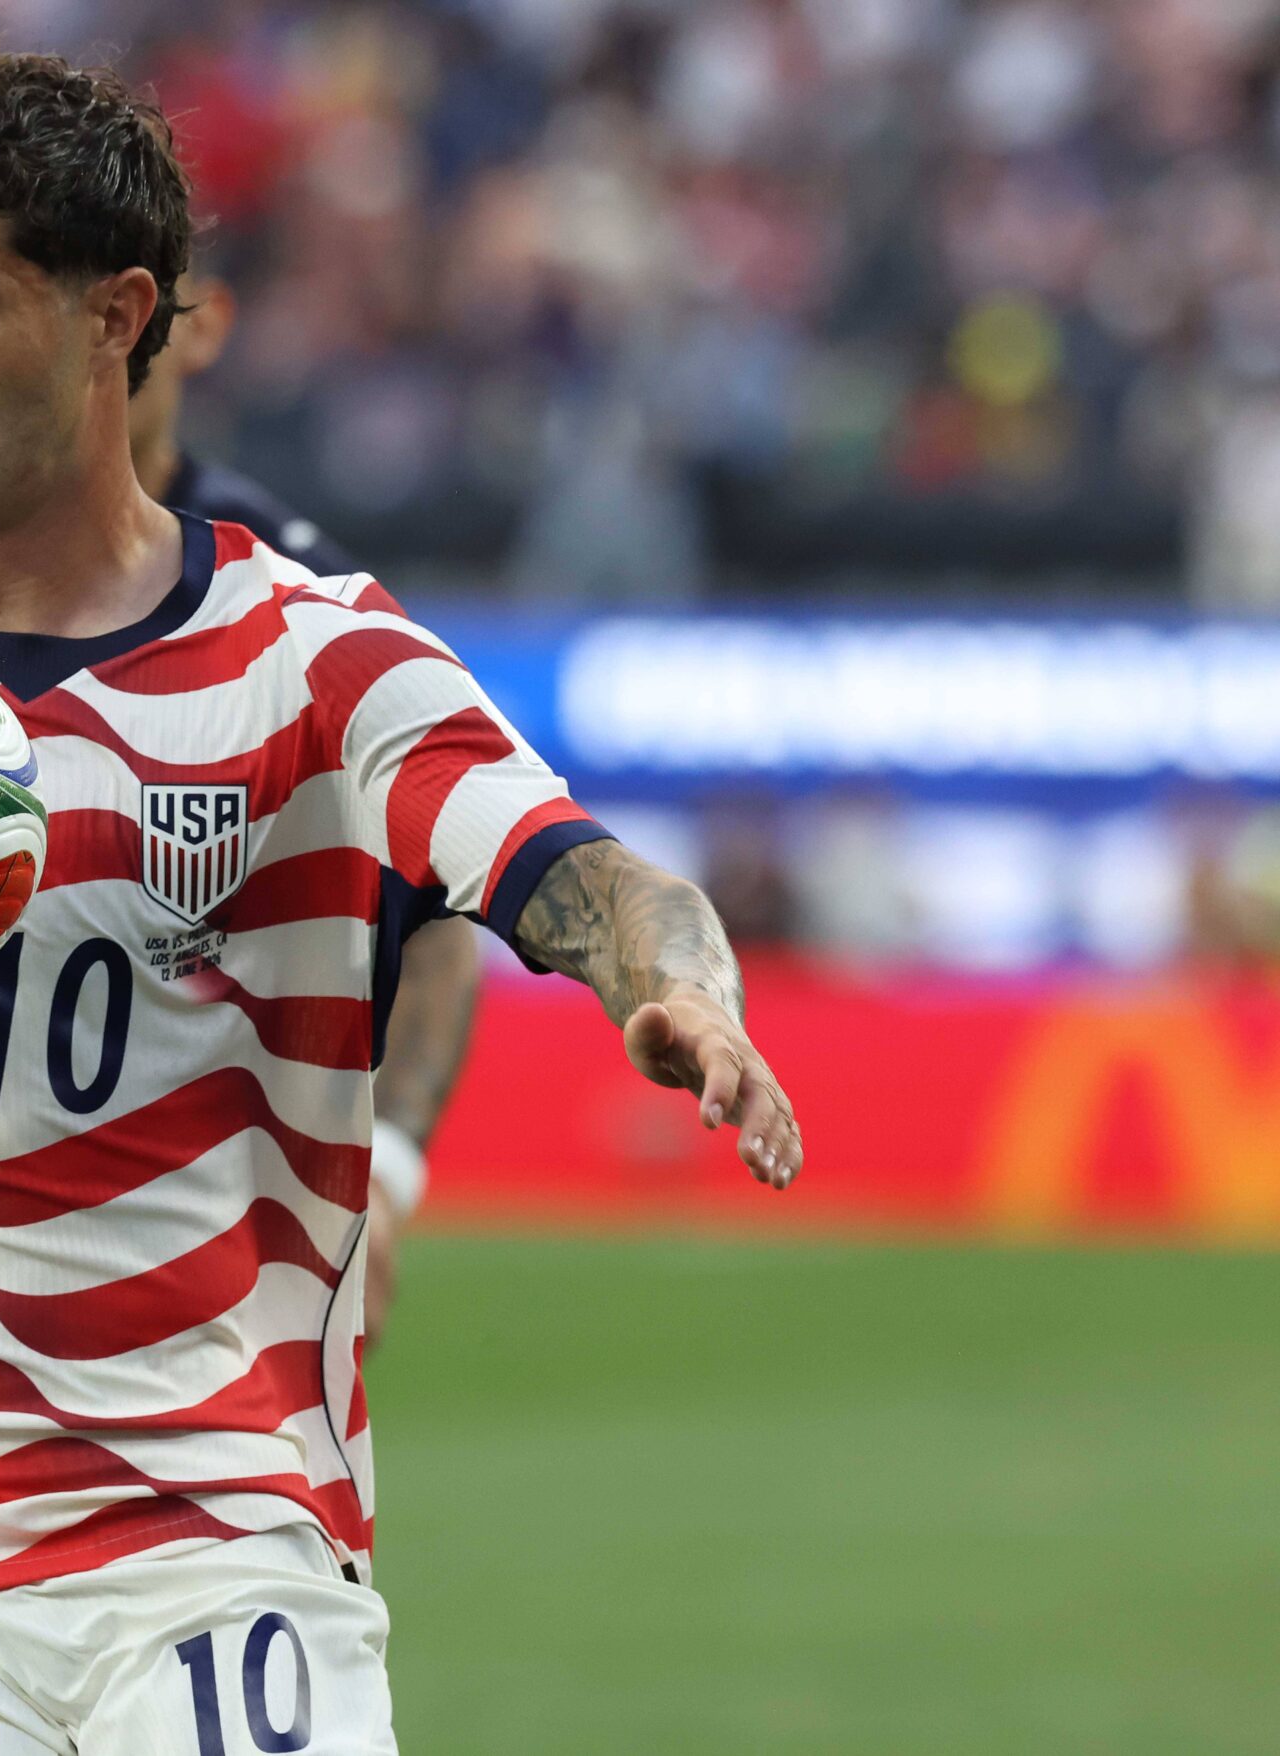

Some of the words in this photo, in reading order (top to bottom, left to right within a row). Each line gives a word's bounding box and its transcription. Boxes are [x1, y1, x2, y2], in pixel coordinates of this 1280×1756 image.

[150, 793, 240, 846] USA
[145, 937, 168, 950] USA
[150, 953, 171, 966] LOS
[216, 932, 227, 947] CA
[161, 967, 171, 981] 12
[174, 1611, 312, 1756] 10
